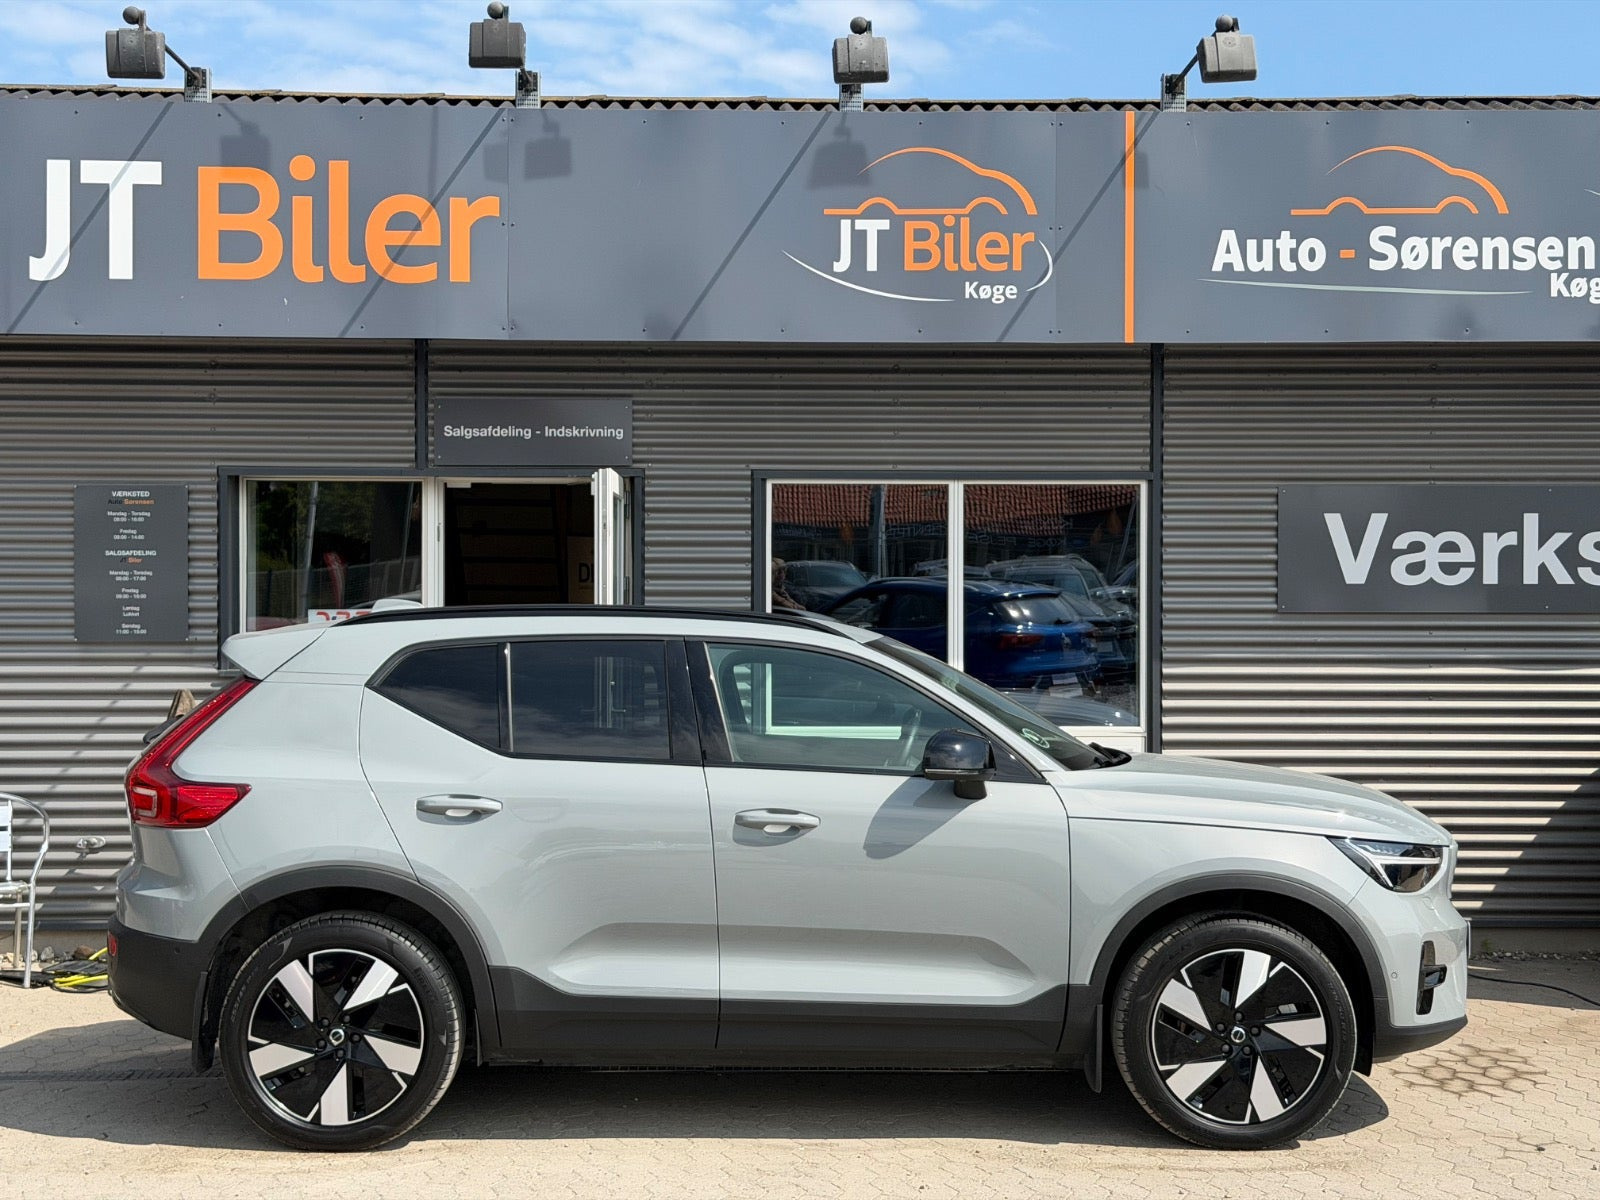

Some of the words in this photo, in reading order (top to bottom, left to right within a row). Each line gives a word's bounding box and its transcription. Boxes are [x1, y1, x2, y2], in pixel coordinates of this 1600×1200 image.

[29, 159, 162, 281] JT
[197, 154, 500, 284] Biler
[833, 219, 890, 273] JT
[903, 214, 1035, 272] Biler
[1211, 229, 1327, 272] Auto
[1368, 225, 1596, 272] Sørensen
[964, 280, 1018, 305] Køge
[443, 425, 532, 440] Salgsafdeling
[544, 425, 624, 440] Indskrivning
[111, 490, 151, 498] VÆRKSTED
